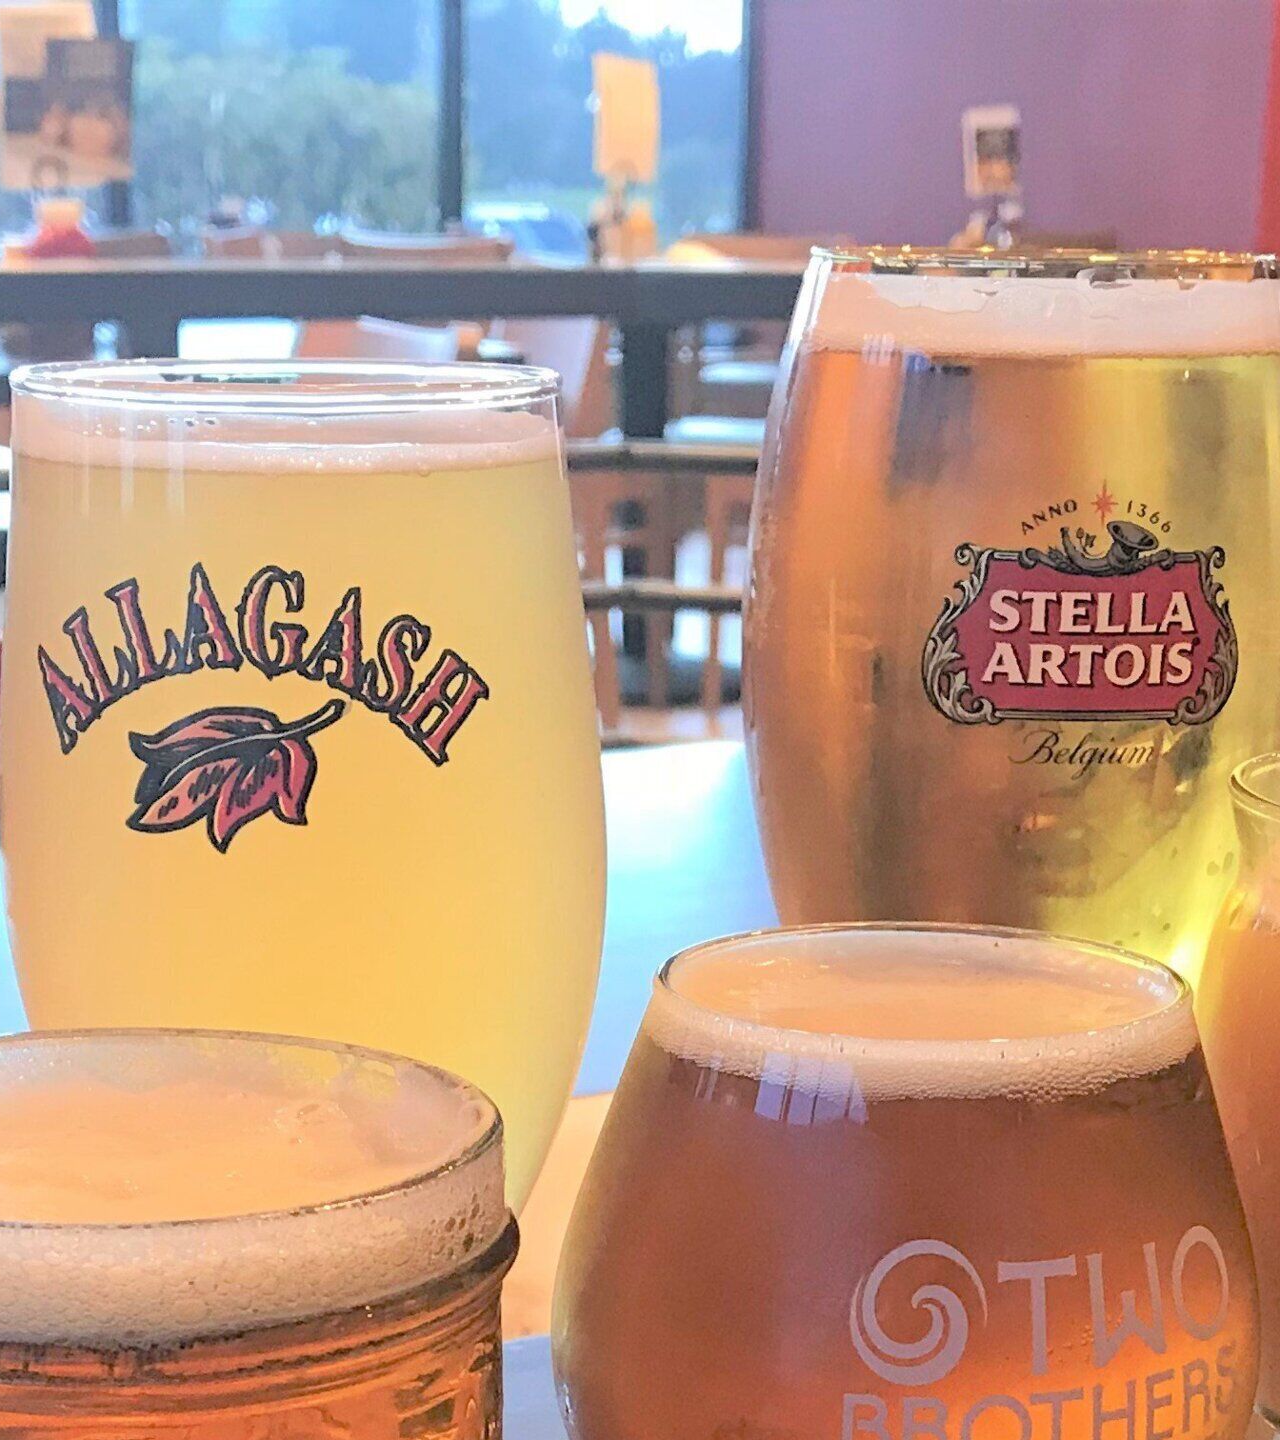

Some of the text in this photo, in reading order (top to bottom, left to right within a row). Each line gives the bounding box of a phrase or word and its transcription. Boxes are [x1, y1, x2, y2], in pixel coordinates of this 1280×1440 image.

[1020, 498, 1172, 535] ANNO 1366
[988, 589, 1195, 634] STELLA
[37, 562, 490, 768] ALLAGASH
[980, 641, 1194, 687] ARTOIS
[1008, 729, 1155, 780] Belgium
[997, 1225, 1230, 1376] TWO
